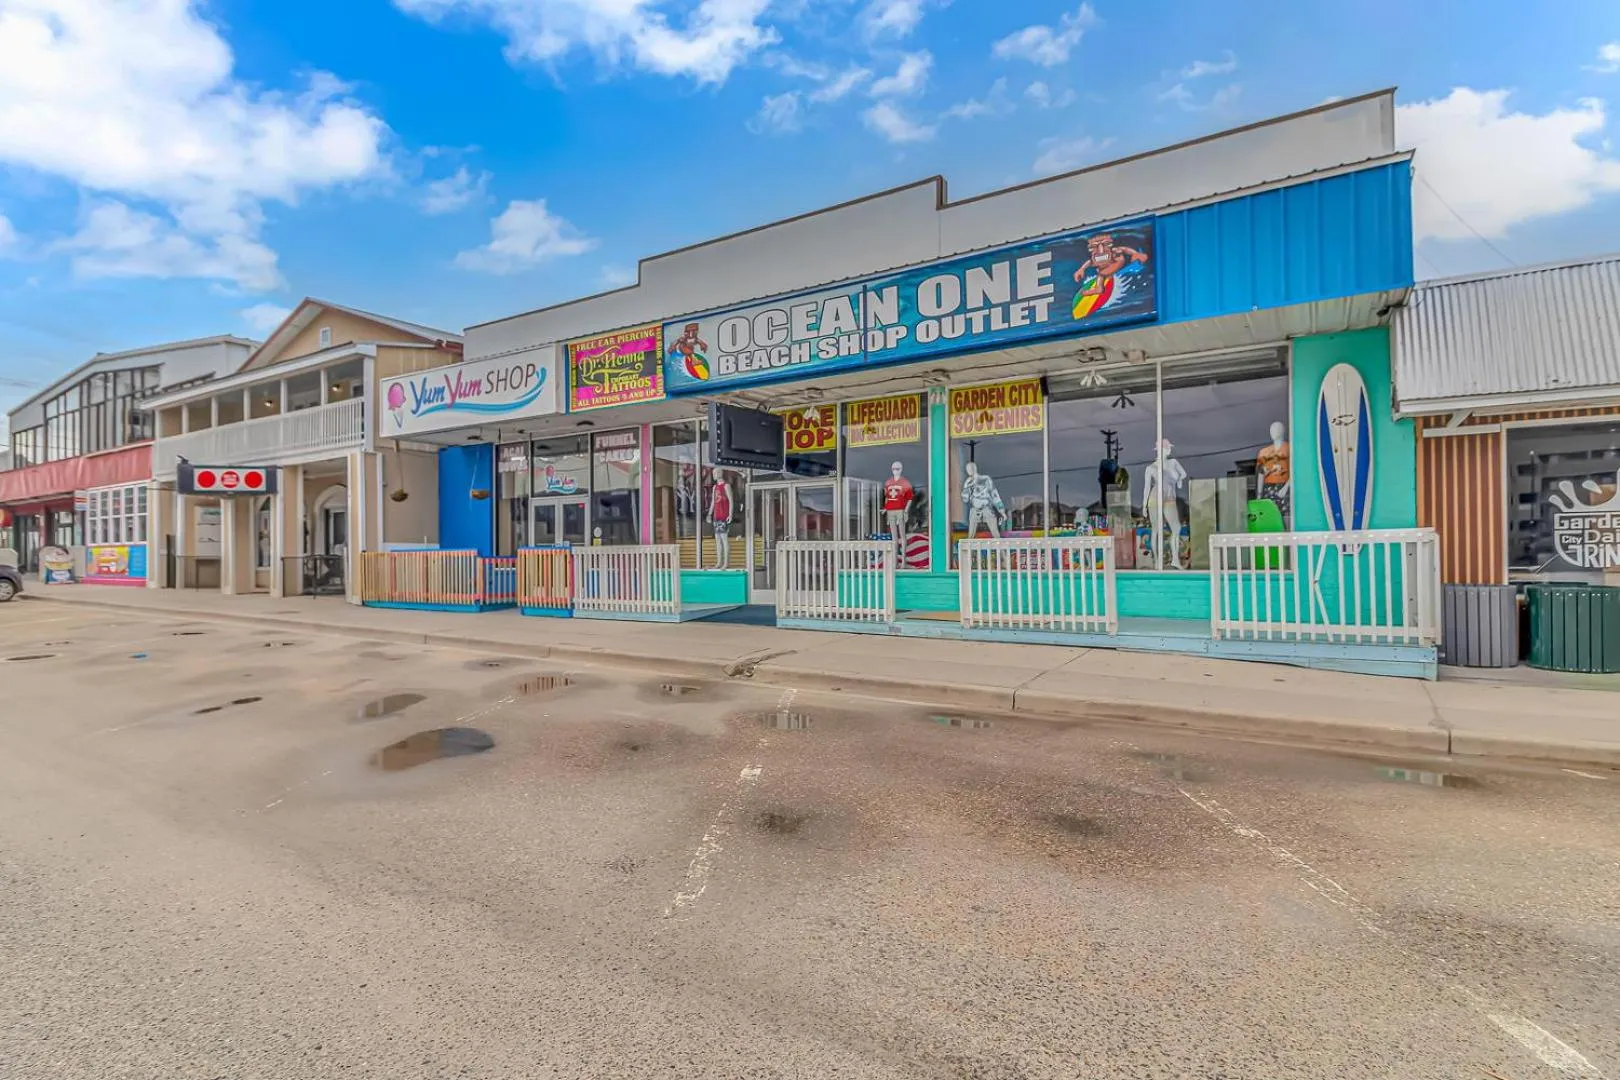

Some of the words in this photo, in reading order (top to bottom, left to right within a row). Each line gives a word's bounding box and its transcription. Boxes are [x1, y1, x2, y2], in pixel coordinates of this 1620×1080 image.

[718, 285, 899, 353] OCEAN
[917, 251, 1054, 317] ONE
[576, 341, 594, 352] FREE
[617, 329, 655, 343] PIERCING
[718, 341, 811, 376] BEACH
[817, 325, 907, 360] SHOP
[916, 296, 1054, 343] OUTLET
[410, 377, 445, 414] Yum
[444, 368, 482, 409] Yum
[485, 363, 536, 394] SHOP
[954, 386, 1005, 412] GARDEN
[1009, 383, 1040, 405] CITY
[783, 407, 834, 430] OKE
[851, 397, 917, 424] LIFEGUARD
[954, 405, 1040, 433] SOUVENIRS
[786, 427, 834, 449] OP
[1554, 512, 1620, 529] Garde
[1584, 529, 1620, 544] Dai
